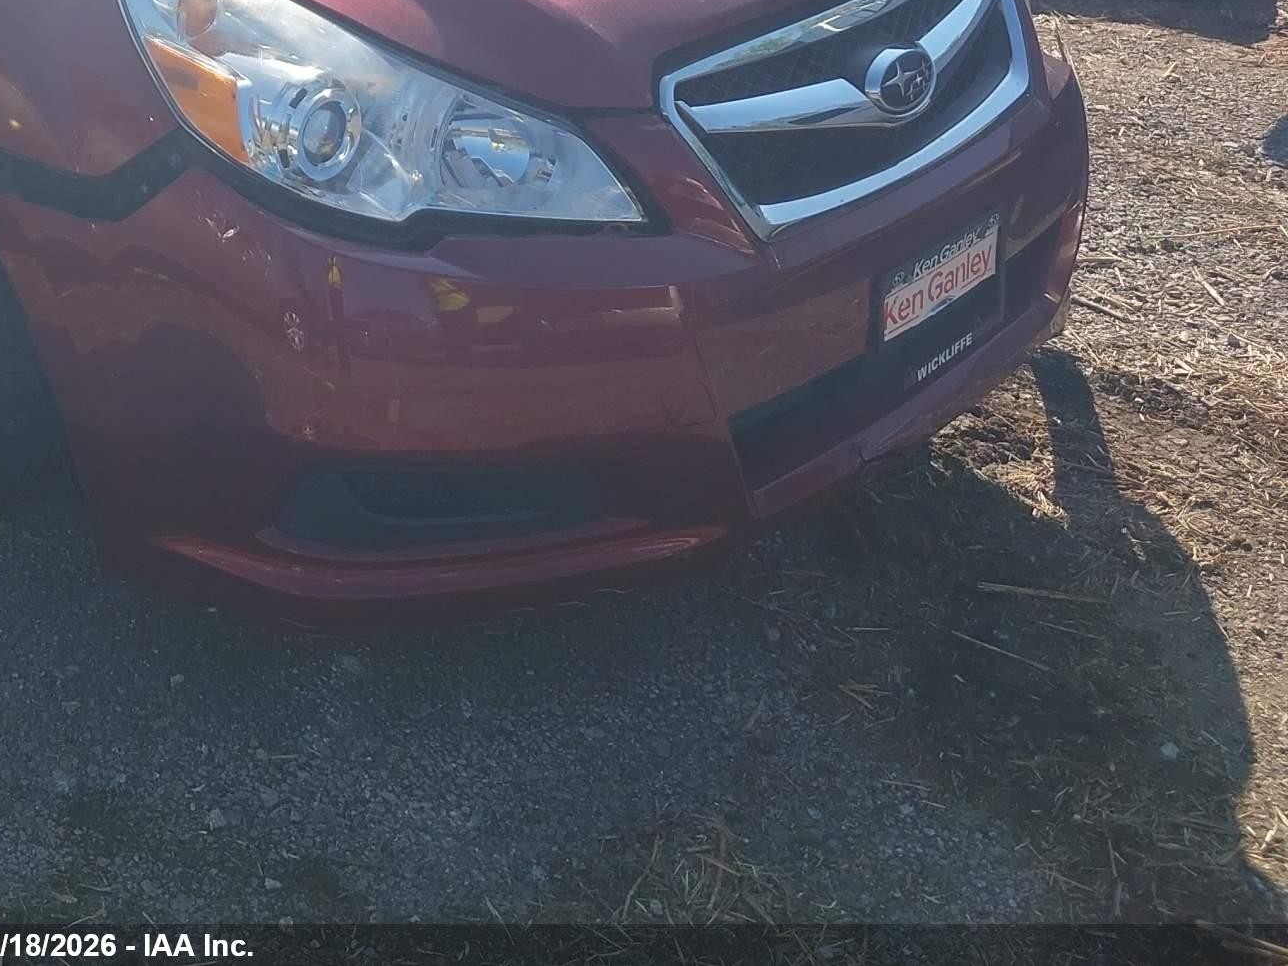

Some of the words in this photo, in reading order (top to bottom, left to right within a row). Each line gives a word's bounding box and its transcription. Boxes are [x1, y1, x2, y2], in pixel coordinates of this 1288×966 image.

[913, 256, 939, 279] Ken
[940, 227, 981, 263] Ganley
[884, 289, 924, 325] Ken
[928, 245, 992, 302] Ganley
[917, 332, 973, 381] WICKLIFFE
